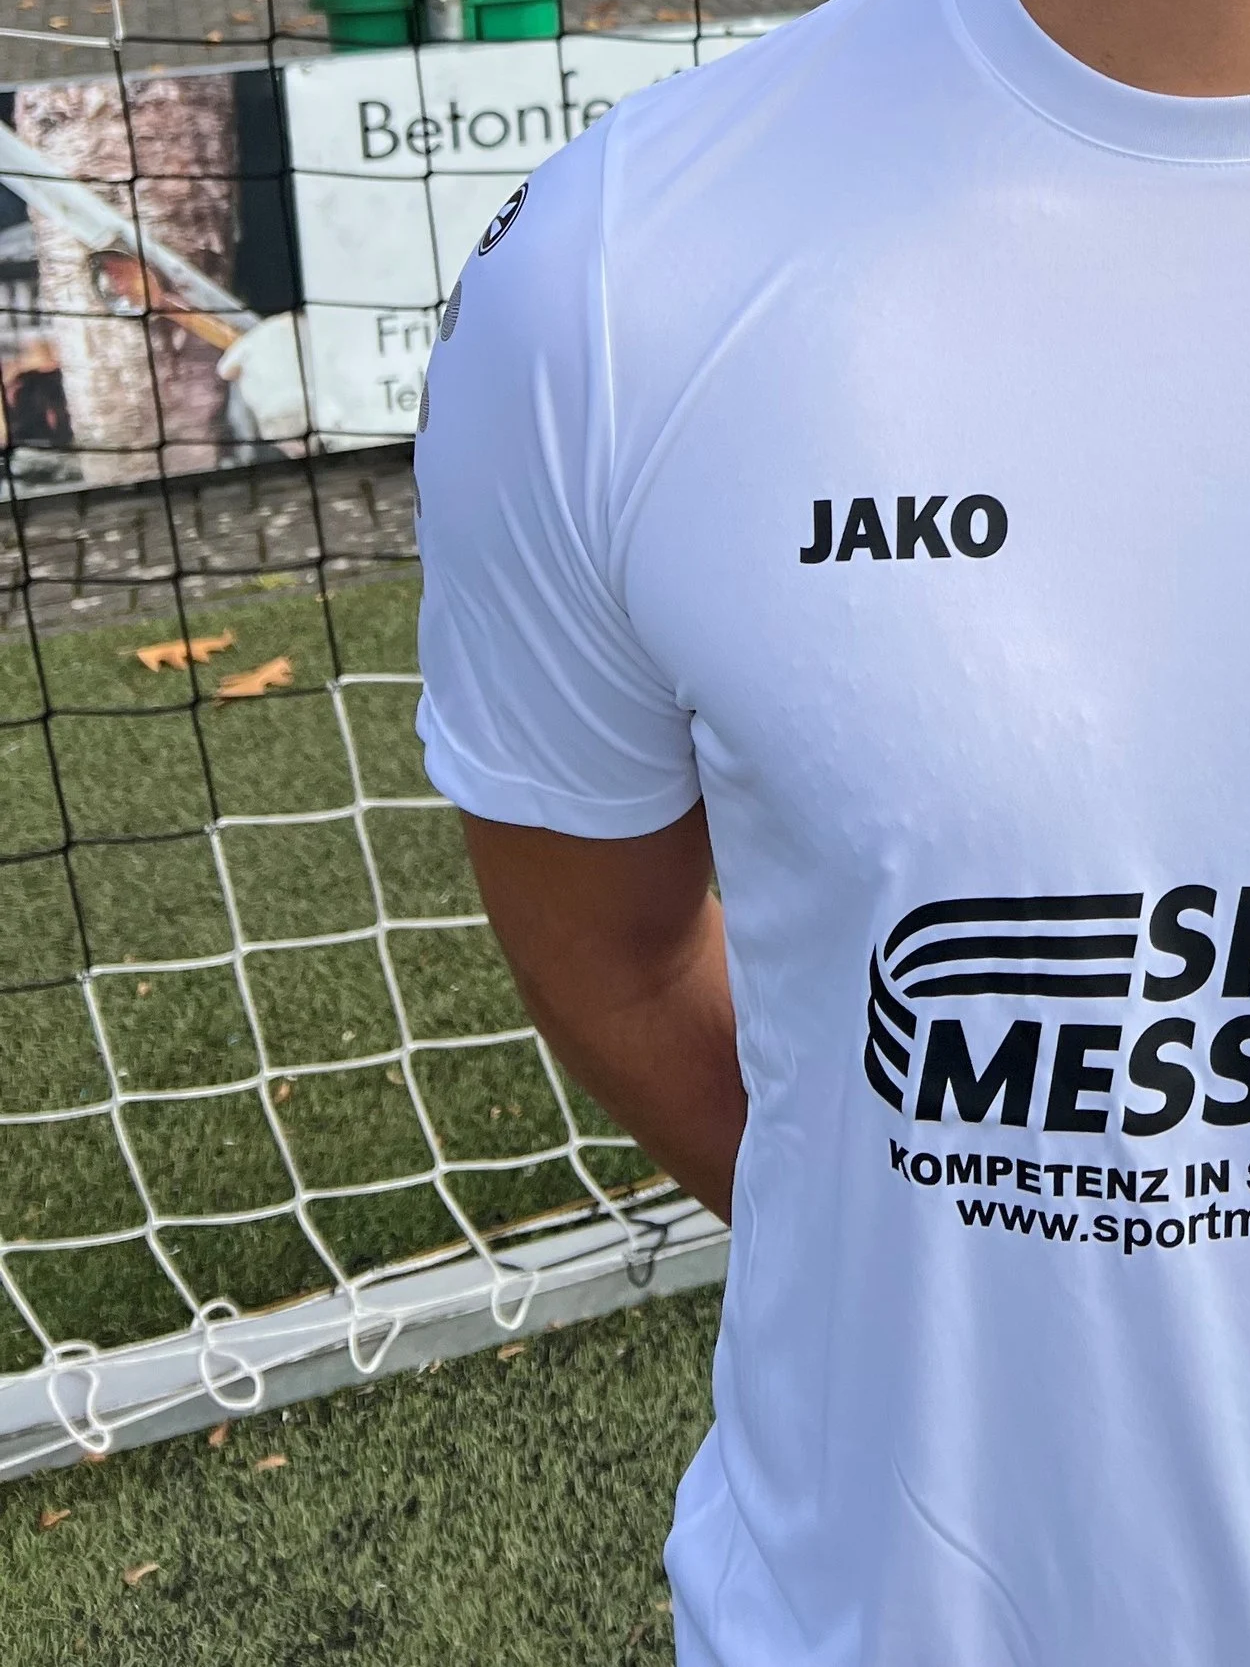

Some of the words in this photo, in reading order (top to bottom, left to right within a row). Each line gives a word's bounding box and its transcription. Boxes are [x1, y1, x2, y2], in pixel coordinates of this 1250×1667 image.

[357, 68, 682, 161] Betonfe
[799, 494, 1009, 564] JAKO
[888, 1137, 1170, 1204] KOMPETENZ
[1185, 1159, 1231, 1198] IN
